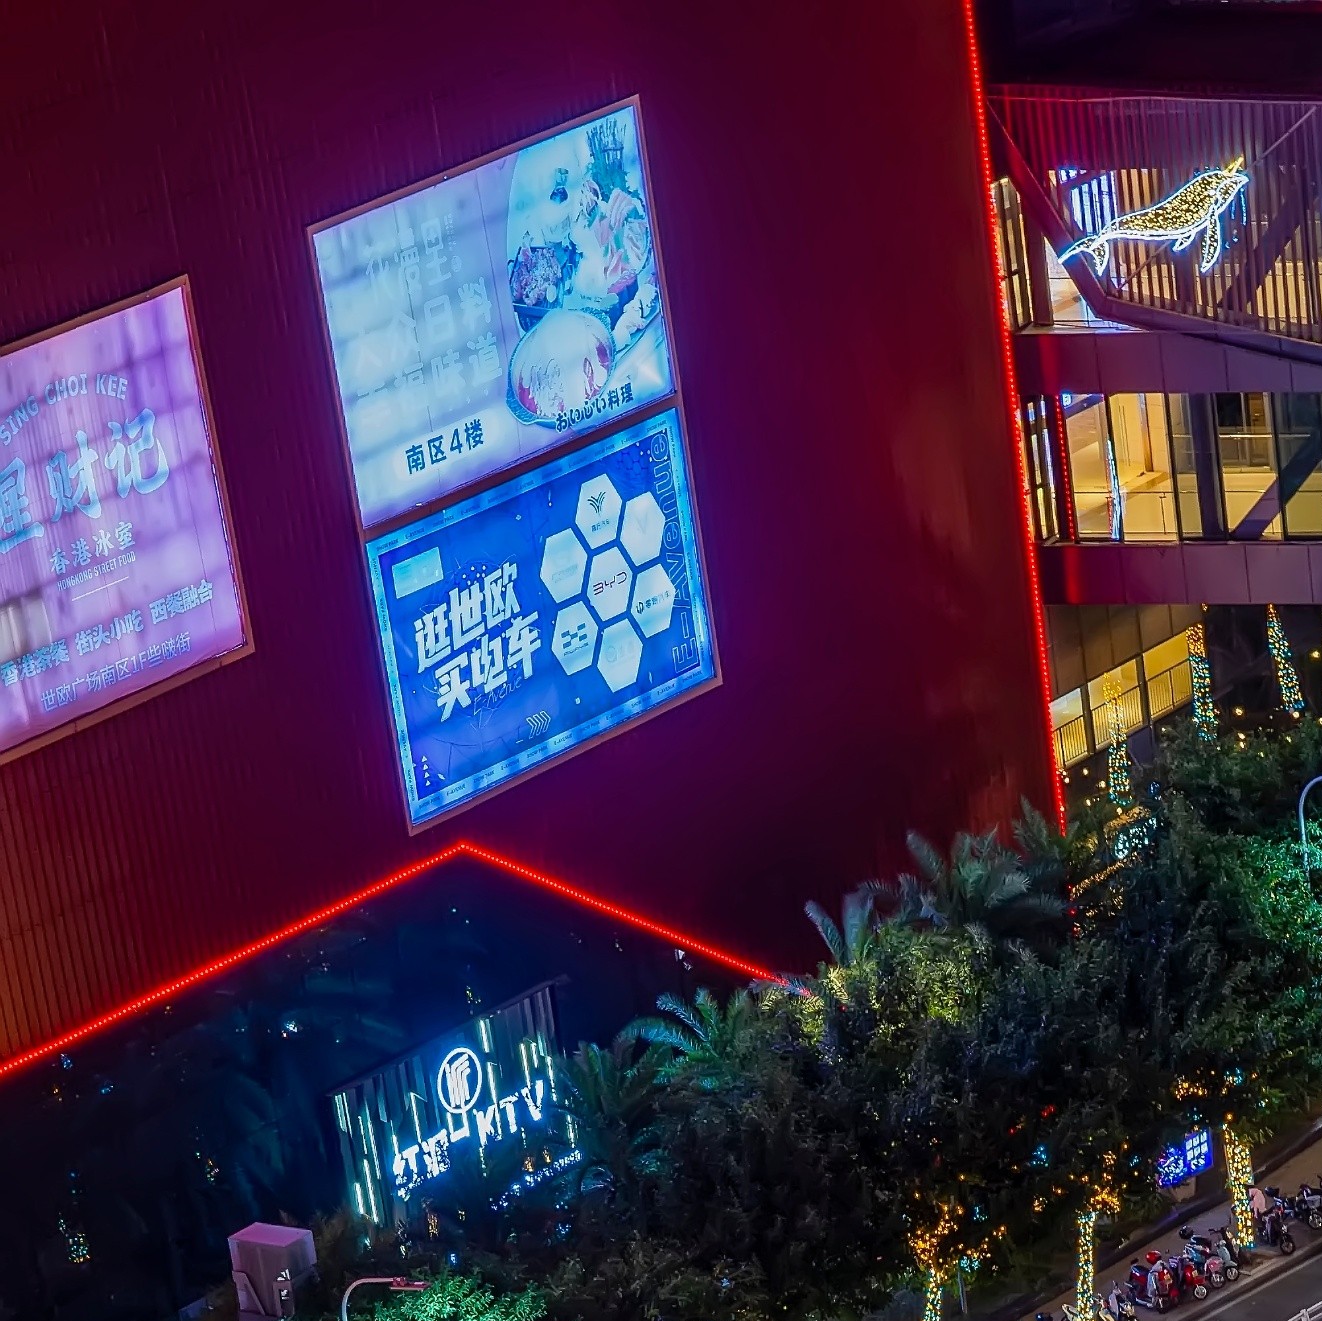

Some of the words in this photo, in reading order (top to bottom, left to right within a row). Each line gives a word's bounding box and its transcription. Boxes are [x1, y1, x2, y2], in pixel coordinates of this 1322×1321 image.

[0, 396, 39, 446] SING
[44, 373, 88, 405] CHOI
[96, 373, 129, 400] KEE
[405, 419, 484, 474] 南区4楼
[50, 521, 136, 574] 香港冰室
[57, 566, 93, 591] HONGKONG
[94, 555, 118, 577] STREET
[118, 550, 136, 567] FOOD
[593, 571, 628, 596] BYD
[1, 638, 70, 687] 香港茶餐
[75, 609, 144, 656] 街头小吃
[149, 579, 213, 625] 西餐融合
[413, 561, 521, 673] 逛世欧
[473, 1079, 544, 1148] KTV
